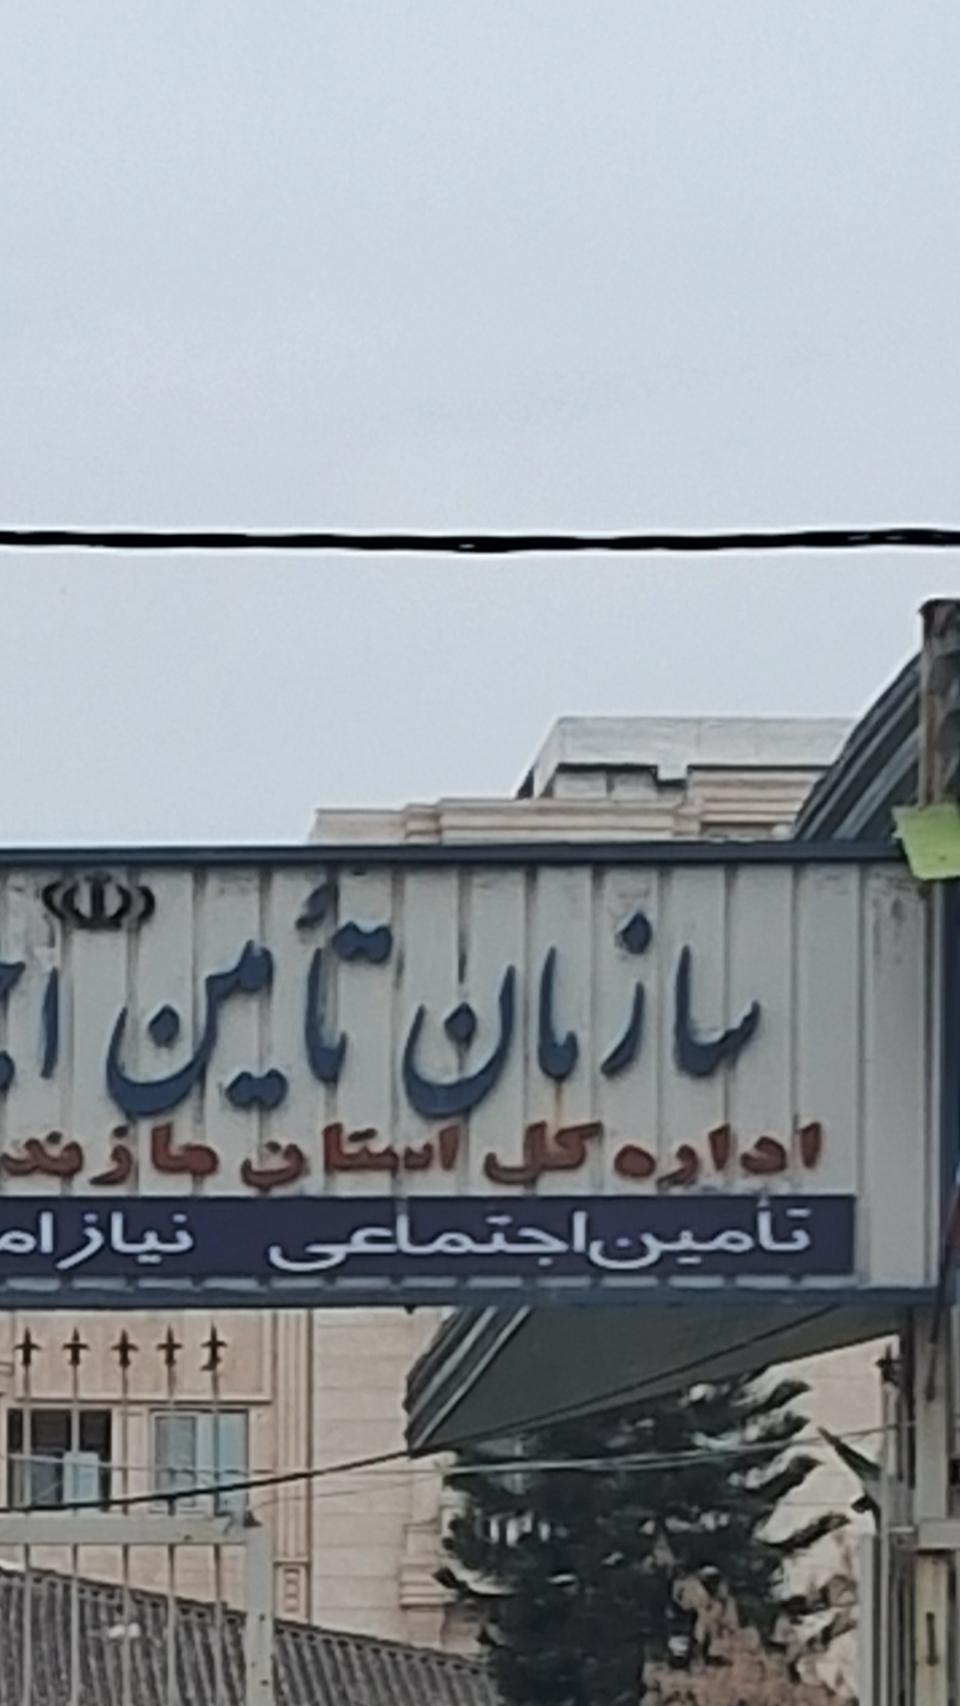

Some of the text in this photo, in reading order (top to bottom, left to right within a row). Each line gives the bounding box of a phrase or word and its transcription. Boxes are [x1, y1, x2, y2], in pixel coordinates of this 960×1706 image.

[402, 907, 761, 1120] سازمان
[240, 1121, 462, 1190] استان
[484, 1120, 603, 1186] کل
[613, 1121, 822, 1187] اداره
[54, 1210, 194, 1271] نیاز
[268, 1209, 588, 1273] اجتماعی
